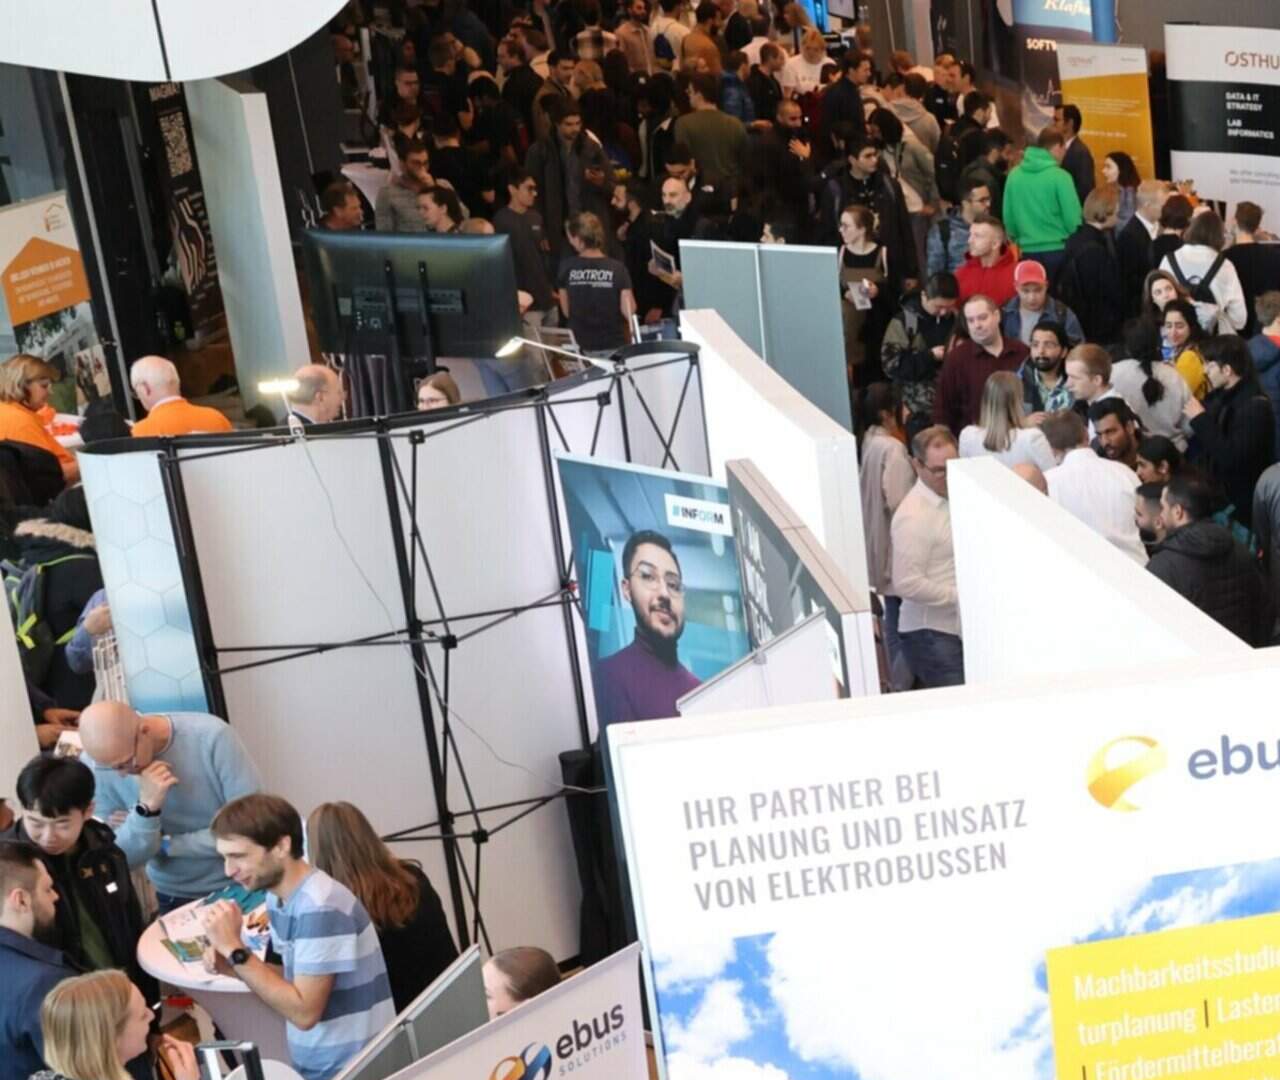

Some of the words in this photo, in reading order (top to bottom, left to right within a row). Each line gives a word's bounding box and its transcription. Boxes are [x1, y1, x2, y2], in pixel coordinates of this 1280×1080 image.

[1225, 92, 1245, 101] DATA
[681, 507, 725, 525] INFORM
[682, 796, 738, 830] IHR
[749, 778, 885, 821] PARTNER
[895, 770, 942, 803] BEI
[688, 825, 831, 871] PLANUNG
[841, 816, 903, 850] UND
[914, 799, 1028, 841] EINSATZ
[694, 876, 756, 911] VON
[767, 841, 1008, 901] ELEKTROBUSSEN
[556, 1004, 624, 1060] ebus
[1076, 1006, 1197, 1047] turplanung
[559, 1031, 628, 1077] SOLUTIONS
